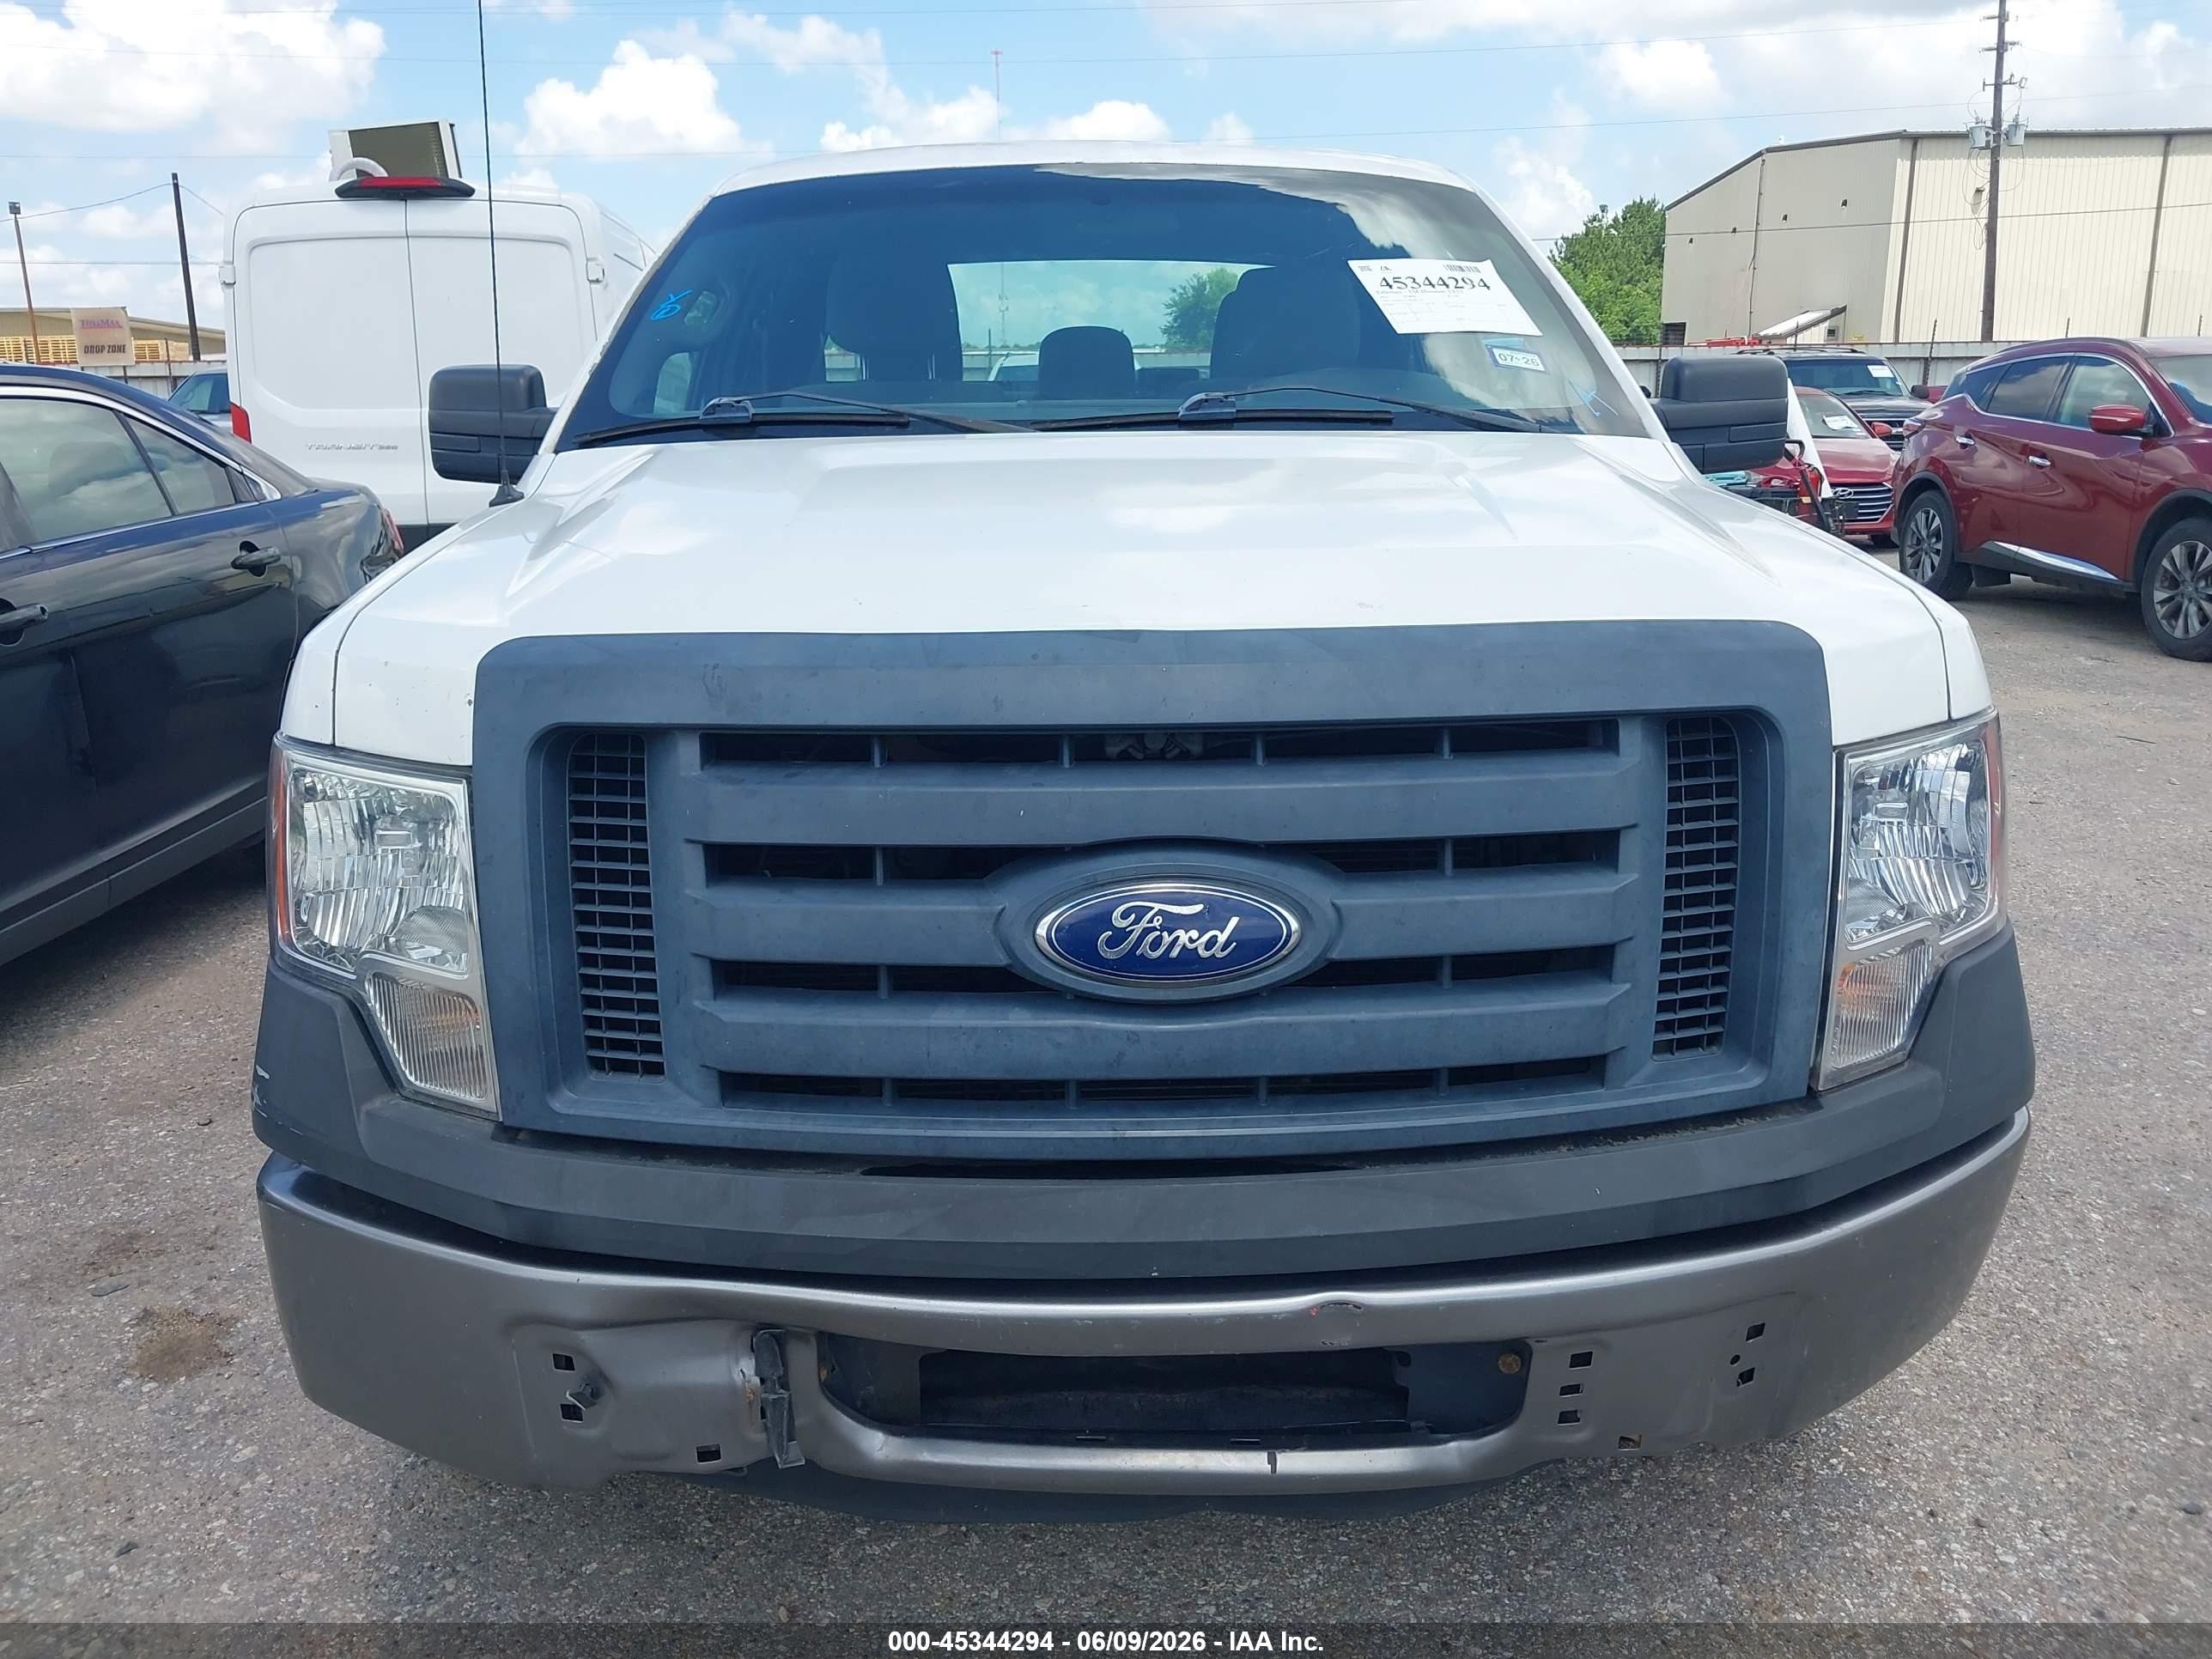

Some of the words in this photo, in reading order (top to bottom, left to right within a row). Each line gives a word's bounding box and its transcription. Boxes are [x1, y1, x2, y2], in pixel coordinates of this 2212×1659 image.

[1380, 276, 1491, 291] 45344294
[83, 344, 106, 354] DROP
[106, 344, 126, 354] ZONE
[1097, 901, 1240, 959] Ford
